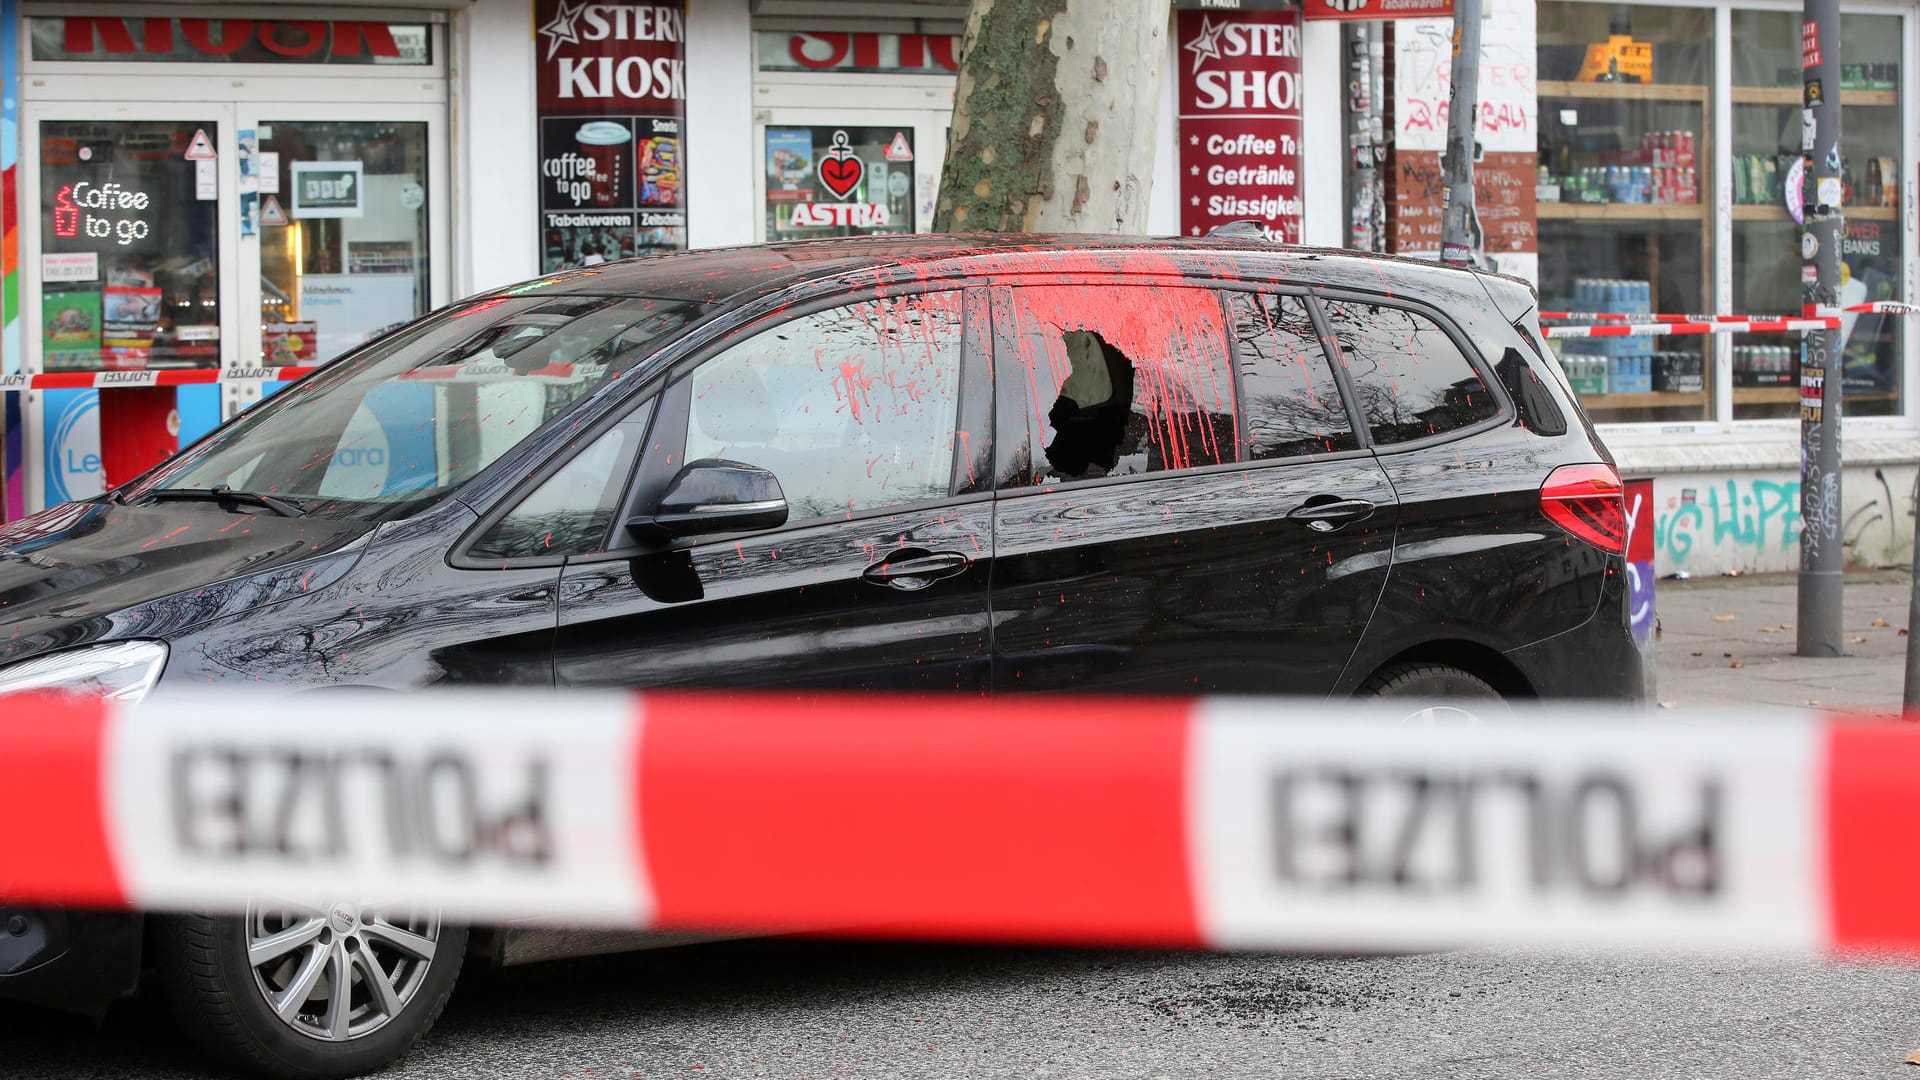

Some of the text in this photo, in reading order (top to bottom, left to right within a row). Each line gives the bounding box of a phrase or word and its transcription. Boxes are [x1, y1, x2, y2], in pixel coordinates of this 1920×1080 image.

[557, 56, 686, 99] KIOSK
[1207, 134, 1277, 155] Coffee
[1280, 134, 1296, 155] To
[543, 152, 597, 180] coffee
[1207, 164, 1295, 185] Getränke
[72, 181, 150, 209] Coffee
[556, 178, 591, 206] to go
[547, 214, 632, 227] Tabakwaren
[790, 203, 890, 227] ASTRA
[86, 214, 149, 245] to go
[1843, 240, 1880, 255] BANKS
[168, 745, 556, 869] POLIZEI
[1268, 767, 1724, 902] POLIZEI
